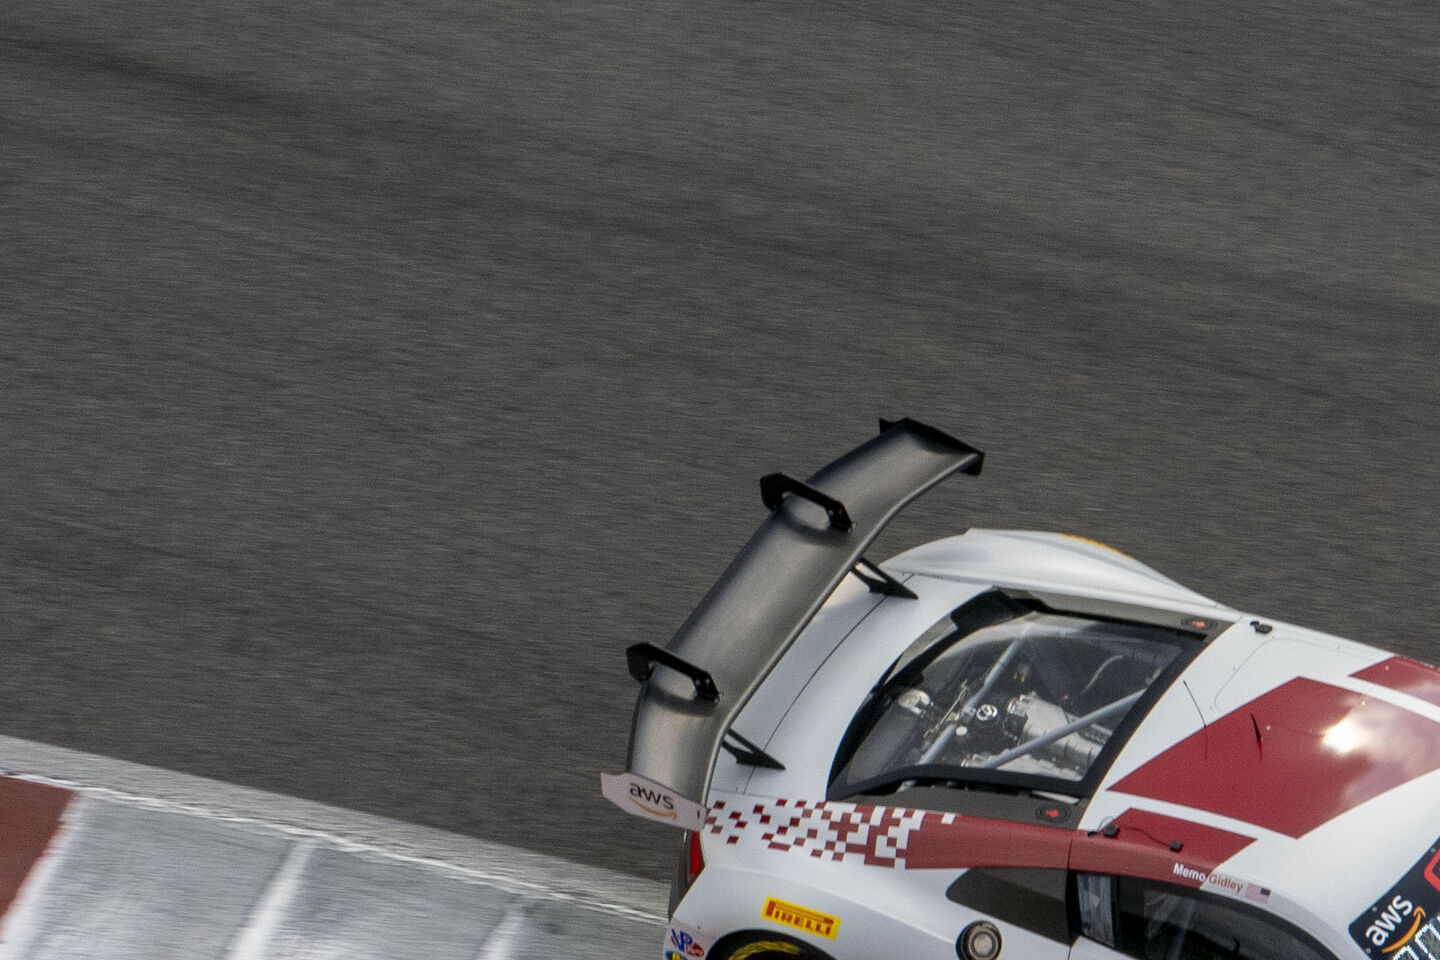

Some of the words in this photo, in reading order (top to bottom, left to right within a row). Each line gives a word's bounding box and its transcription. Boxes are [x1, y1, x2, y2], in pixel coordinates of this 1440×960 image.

[629, 782, 675, 810] aws
[1173, 863, 1206, 881] Memo
[1209, 874, 1243, 892] Gidley
[765, 900, 835, 936] PIRELLI
[1366, 895, 1412, 947] aws
